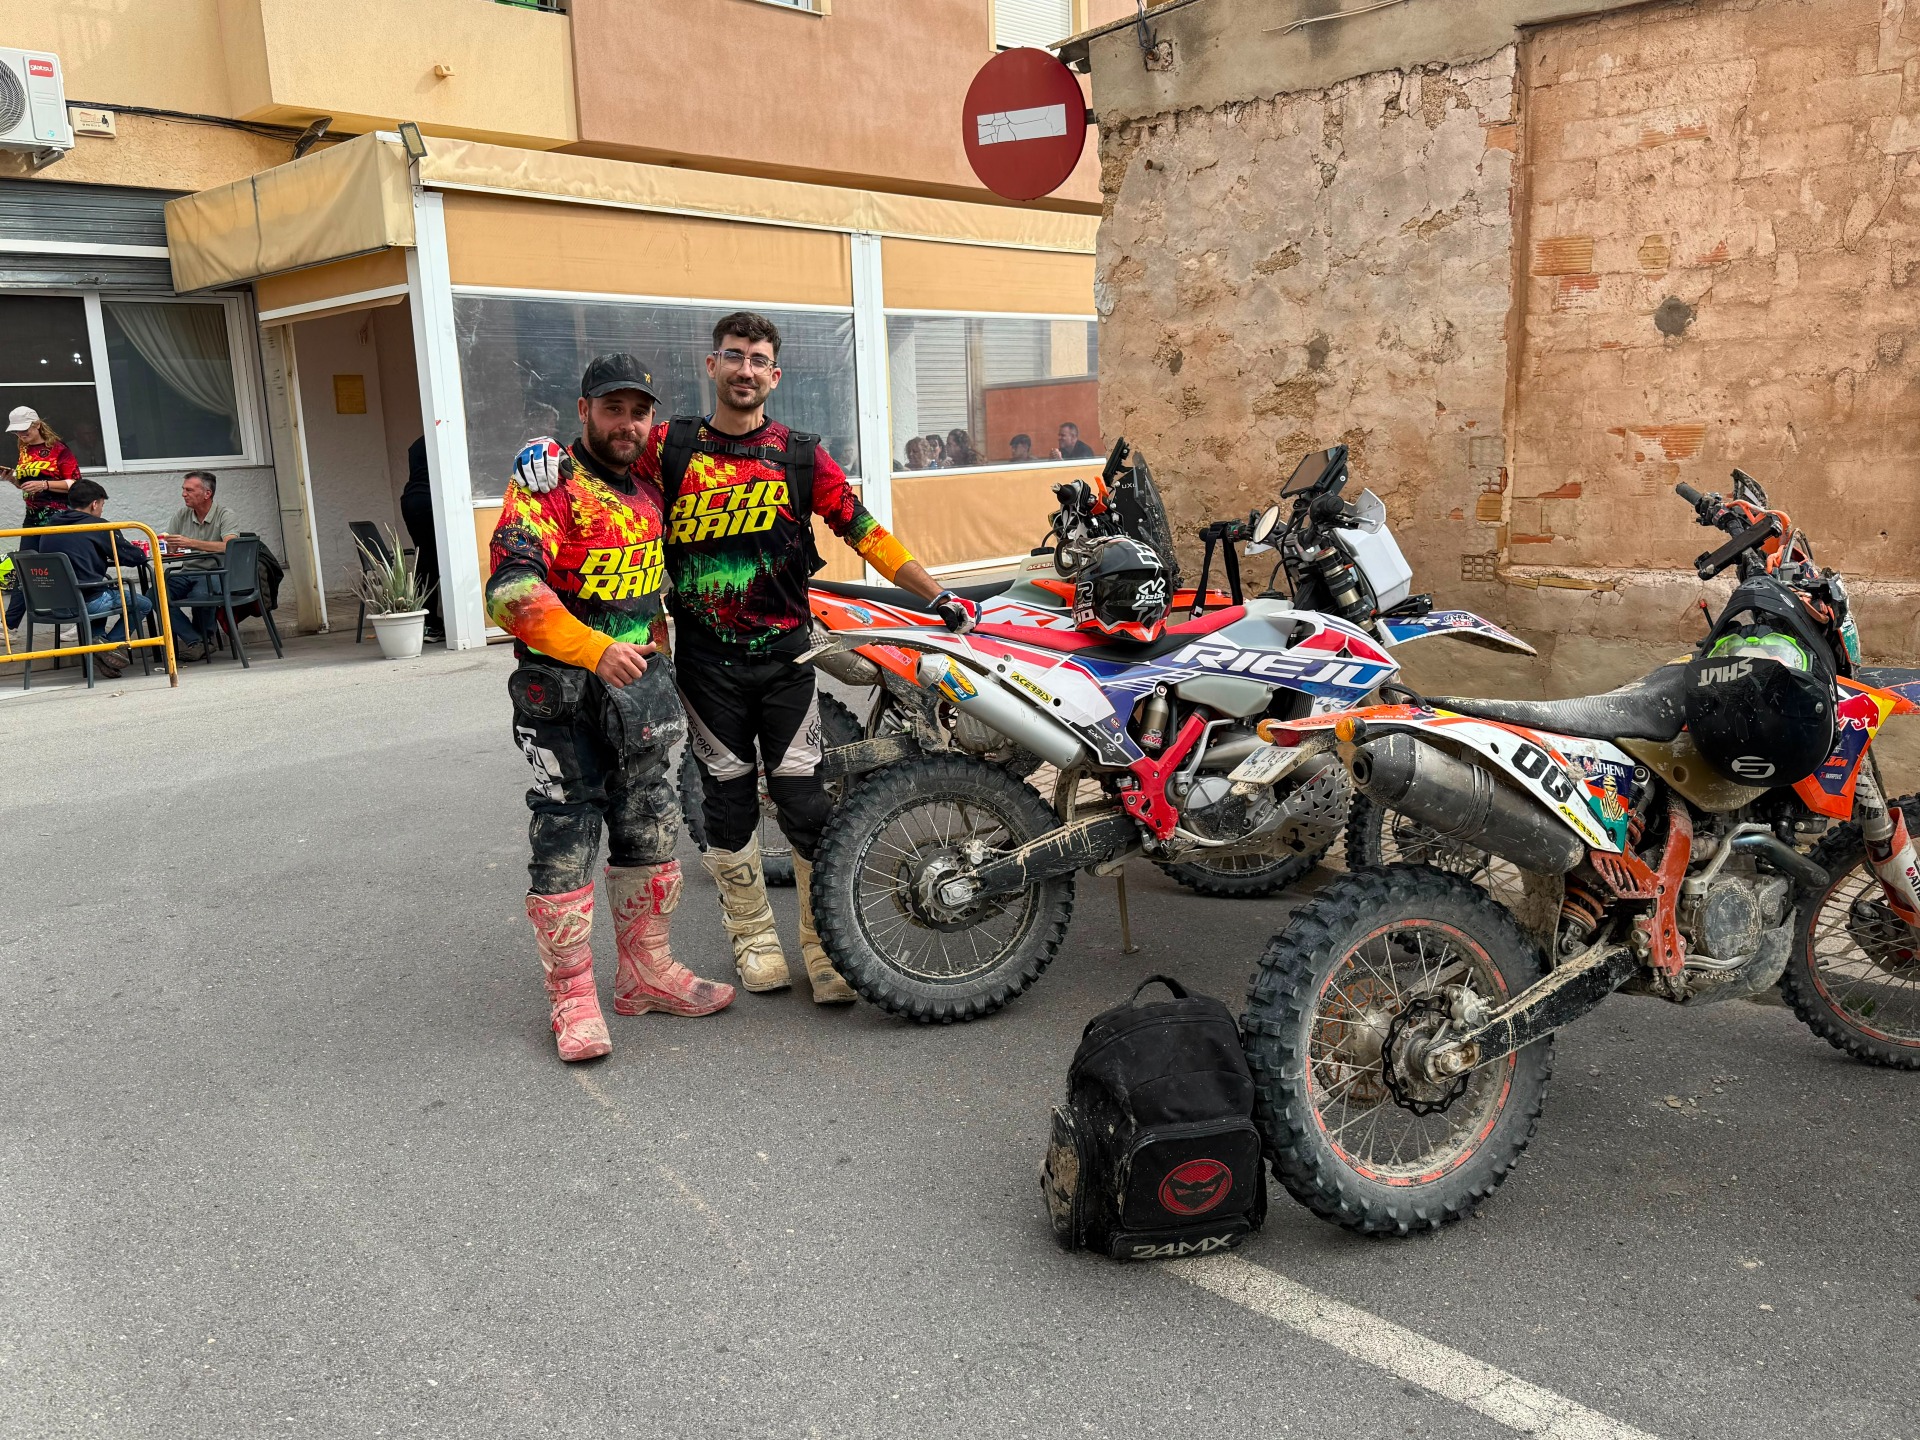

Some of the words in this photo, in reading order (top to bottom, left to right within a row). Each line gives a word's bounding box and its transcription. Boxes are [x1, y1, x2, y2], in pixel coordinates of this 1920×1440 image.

[669, 480, 790, 521] ACHO
[667, 506, 778, 545] RAID
[1172, 645, 1393, 690] RIEJU
[1011, 674, 1050, 701] ACERBIS
[1592, 762, 1626, 779] ATHENA
[1131, 1233, 1233, 1259] 24MX
